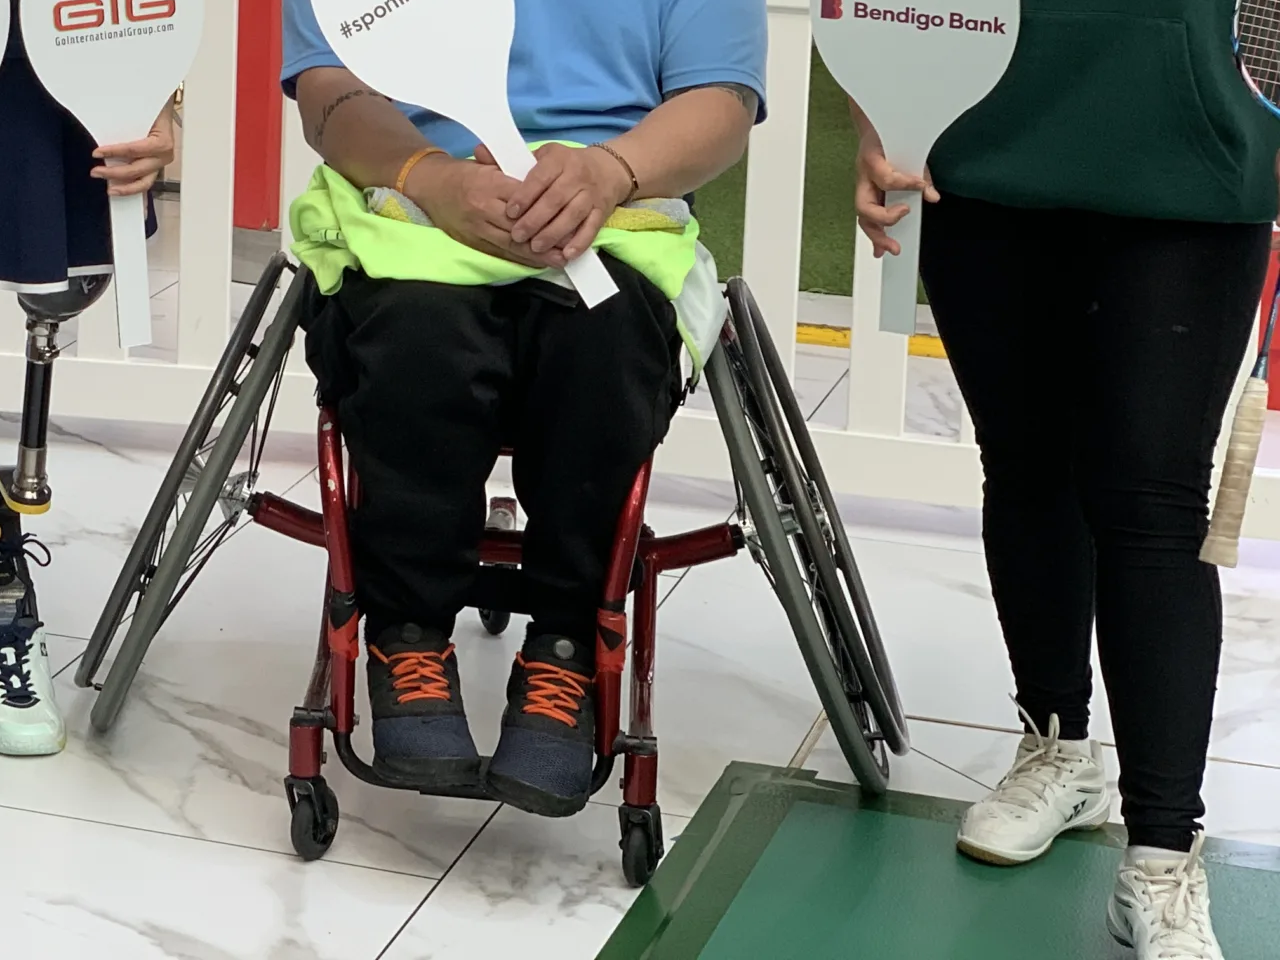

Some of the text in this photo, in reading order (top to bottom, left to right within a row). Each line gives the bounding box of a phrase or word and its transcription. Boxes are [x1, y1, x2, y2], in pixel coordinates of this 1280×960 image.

[853, 1, 945, 31] Bendigo
[948, 11, 1007, 35] Bank
[54, 23, 175, 47] GoInternationalGroup.com
